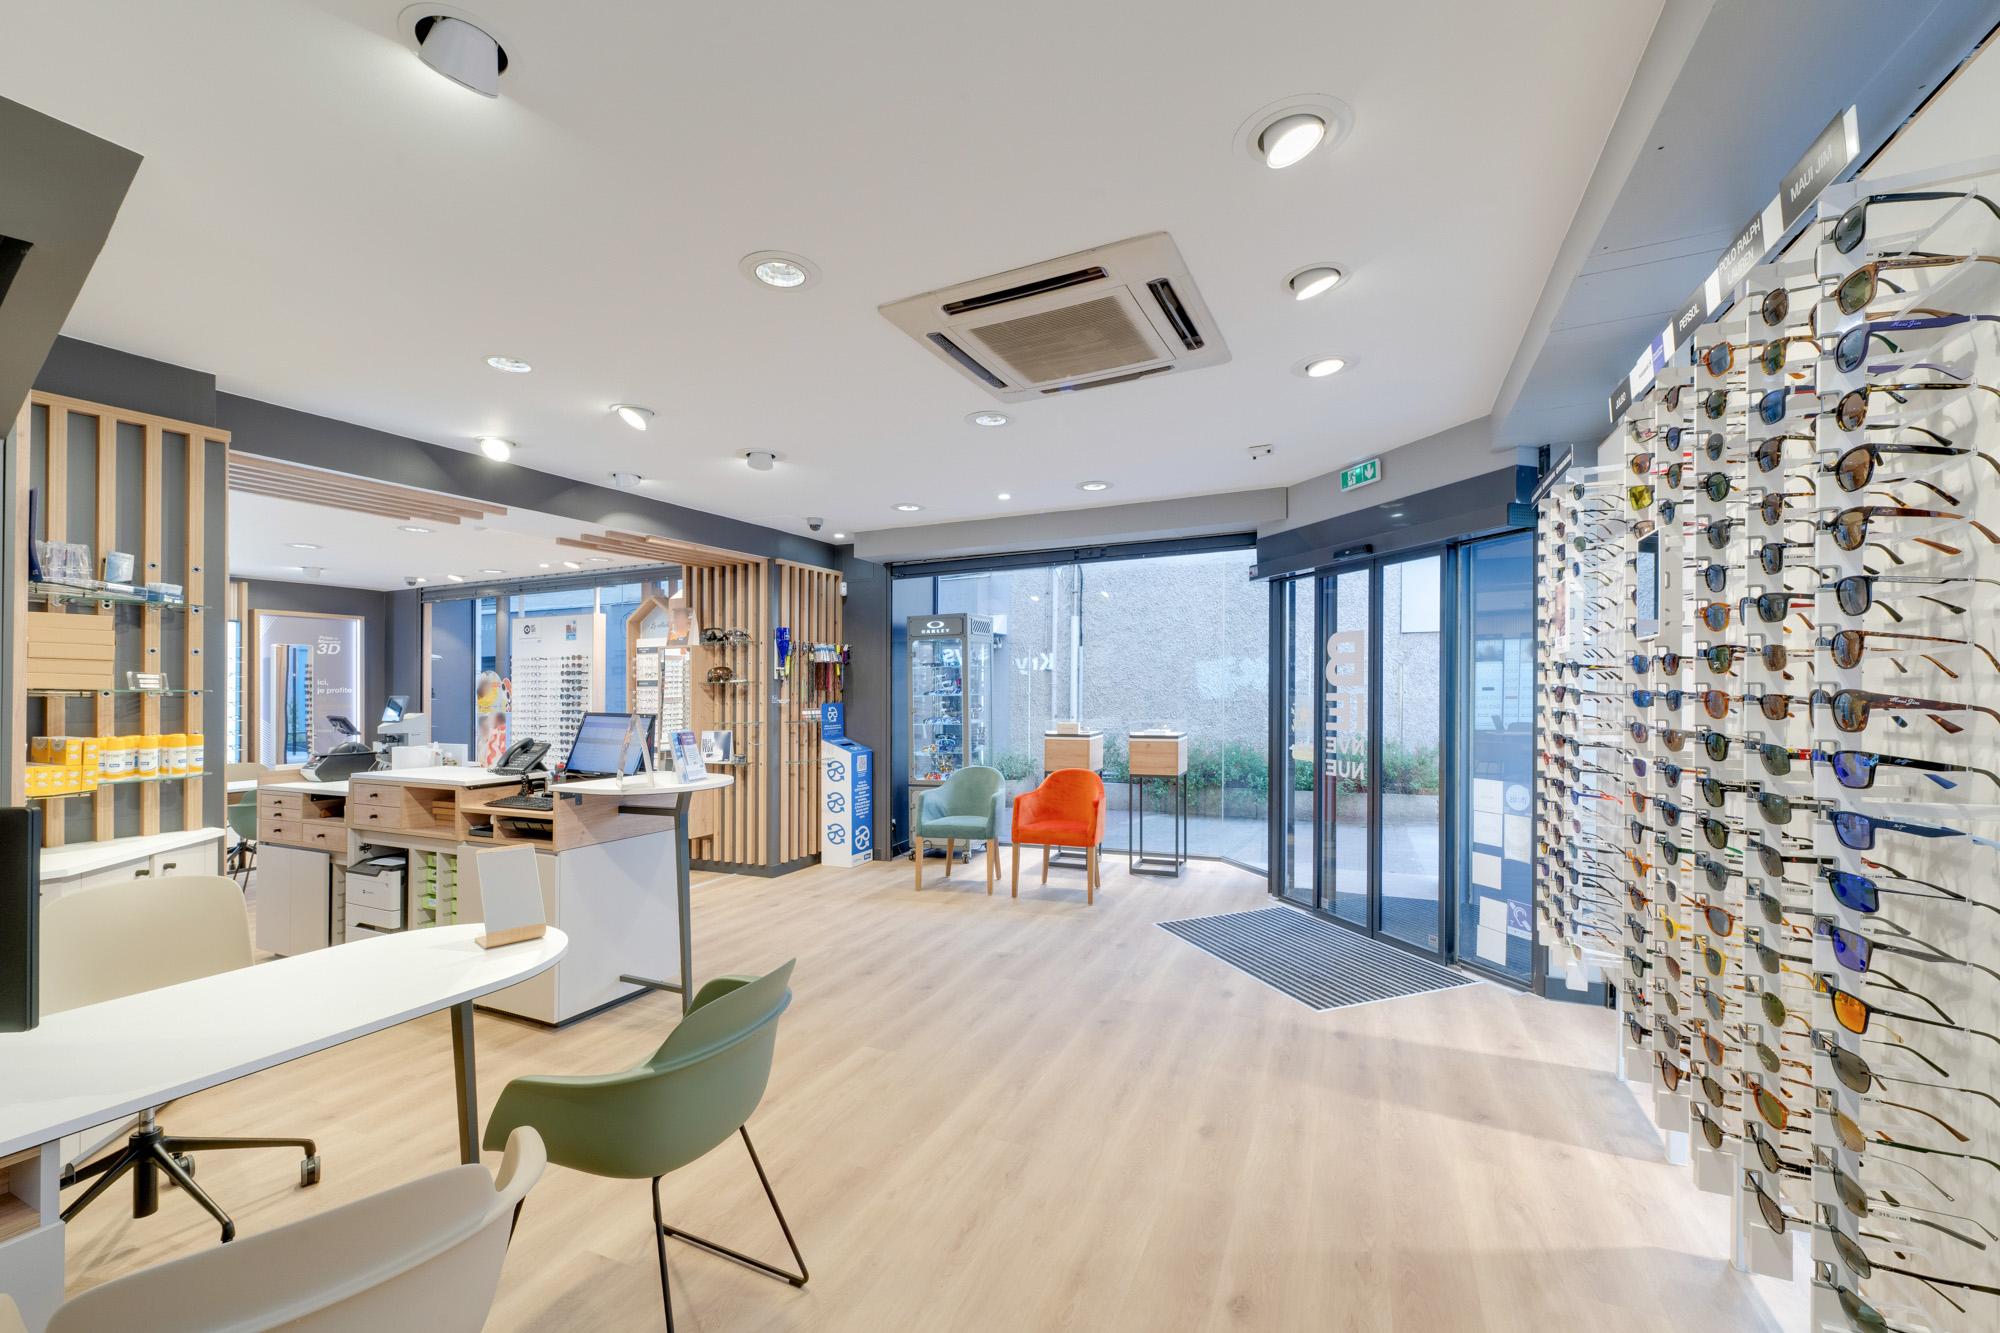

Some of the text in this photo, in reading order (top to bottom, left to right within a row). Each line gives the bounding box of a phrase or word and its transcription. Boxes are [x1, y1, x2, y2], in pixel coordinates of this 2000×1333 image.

[1790, 144, 1833, 203] MAUI JIM
[1719, 218, 1761, 273] POLO RALPH
[1679, 303, 1700, 332] PERSOL
[316, 643, 341, 655] 3D
[326, 687, 353, 695] profite
